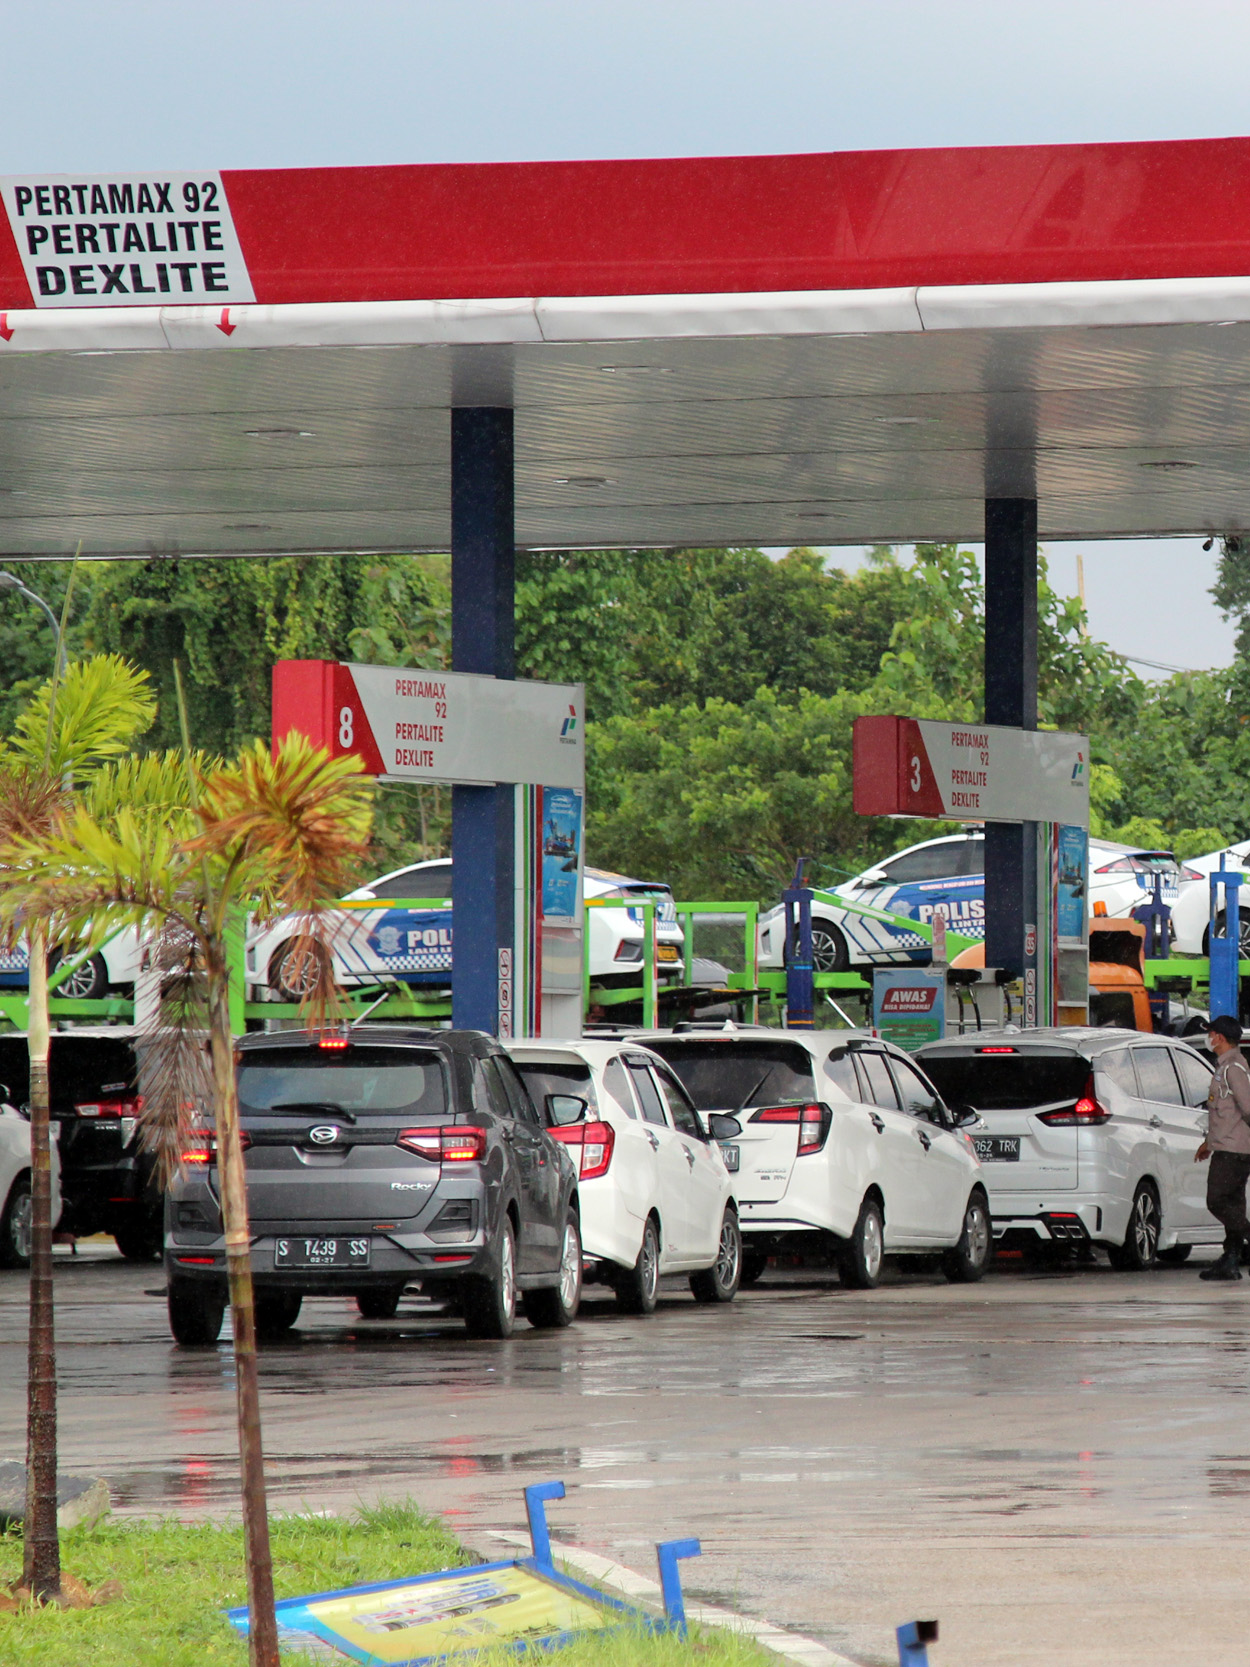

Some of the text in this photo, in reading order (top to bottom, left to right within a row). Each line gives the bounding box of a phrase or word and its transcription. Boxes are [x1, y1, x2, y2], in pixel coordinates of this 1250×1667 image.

[14, 181, 219, 216] PERTAMAX 92
[26, 221, 224, 255] PERTALITE
[36, 262, 229, 295] DEXLITE
[396, 679, 446, 700] PERTAMAX
[435, 702, 447, 719] 92
[339, 706, 354, 748] 8
[396, 723, 443, 743] PERTALITE
[951, 731, 989, 749] PERTAMAX
[396, 749, 434, 767] DEXLITE
[980, 751, 990, 766] 92
[910, 756, 921, 792] 3
[951, 770, 987, 787] PERTALITE
[951, 792, 980, 808] DEXLITE
[407, 929, 453, 947] POL
[890, 990, 928, 1003] AWAS
[999, 1140, 1017, 1152] TRK
[390, 1182, 432, 1191] Rocky
[278, 1239, 368, 1256] S 1439 SS
